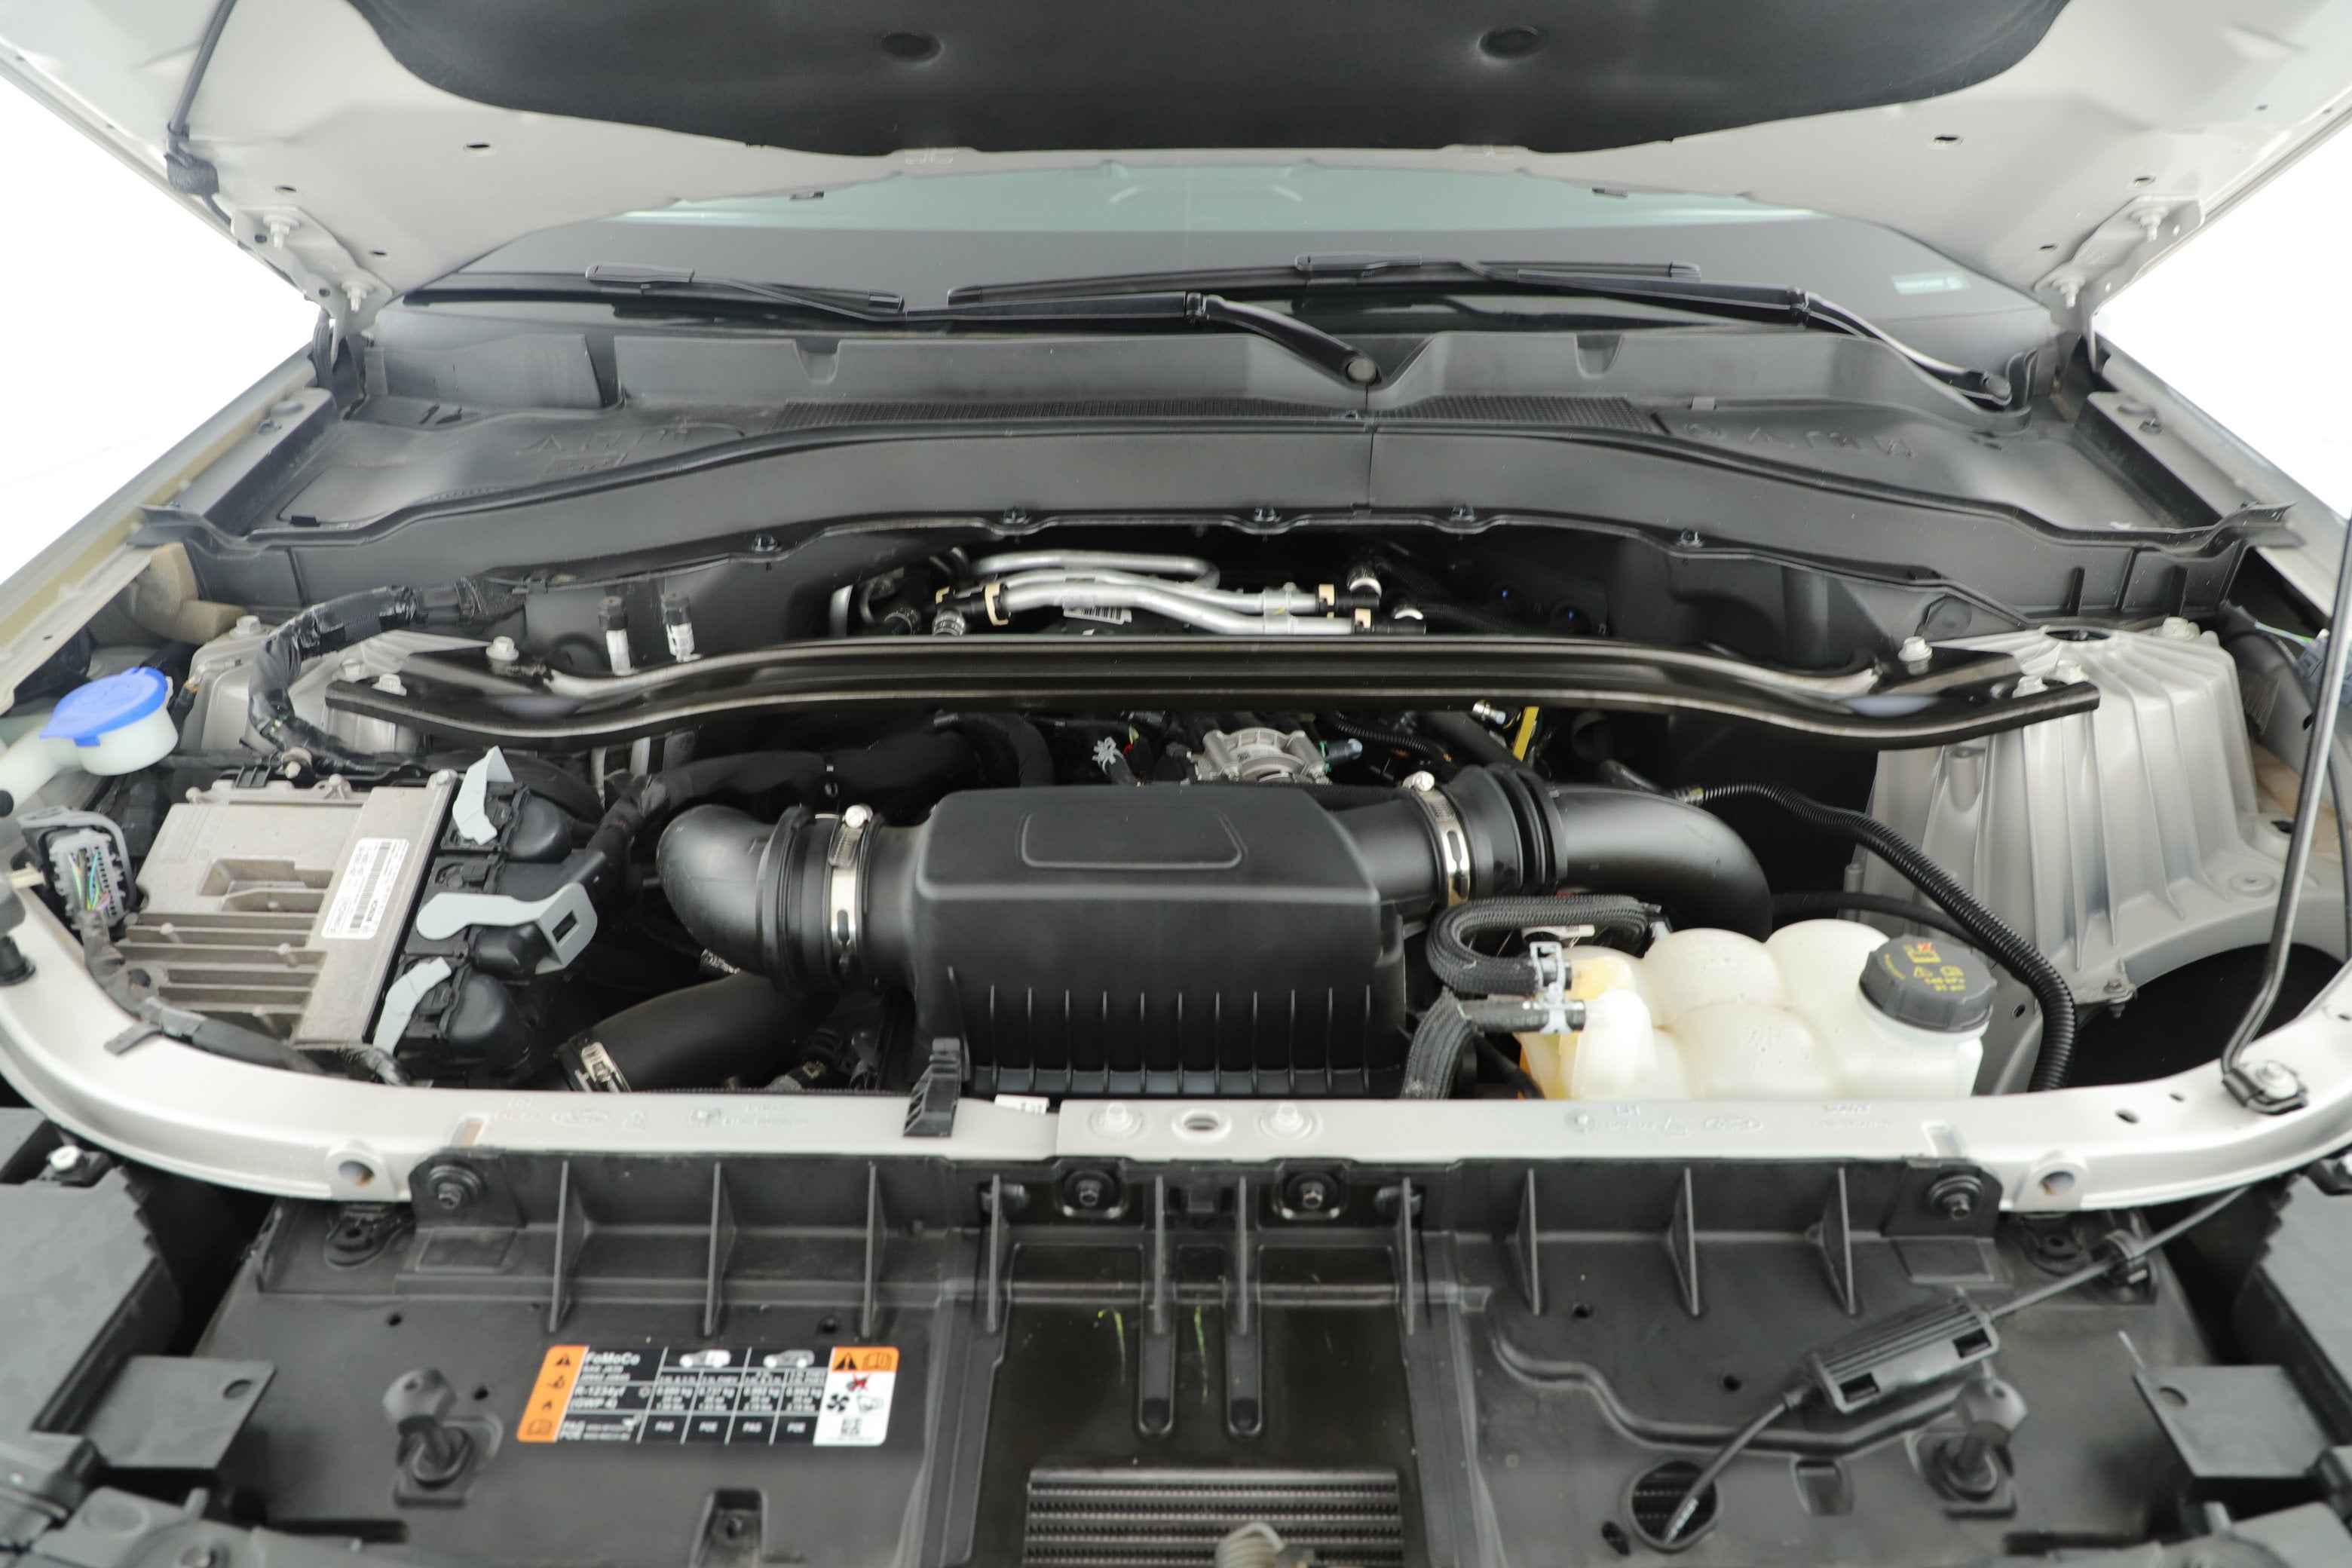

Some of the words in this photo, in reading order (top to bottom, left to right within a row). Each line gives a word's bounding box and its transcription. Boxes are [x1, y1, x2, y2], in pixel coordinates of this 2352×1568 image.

[366, 899, 379, 921] BOSCH
[585, 1351, 641, 1366] FoMoCo
[574, 1387, 626, 1398] R-1234yf
[654, 1421, 675, 1432] PAG
[698, 1421, 718, 1432] POE
[742, 1422, 762, 1433] PAG
[786, 1422, 806, 1433] POE
